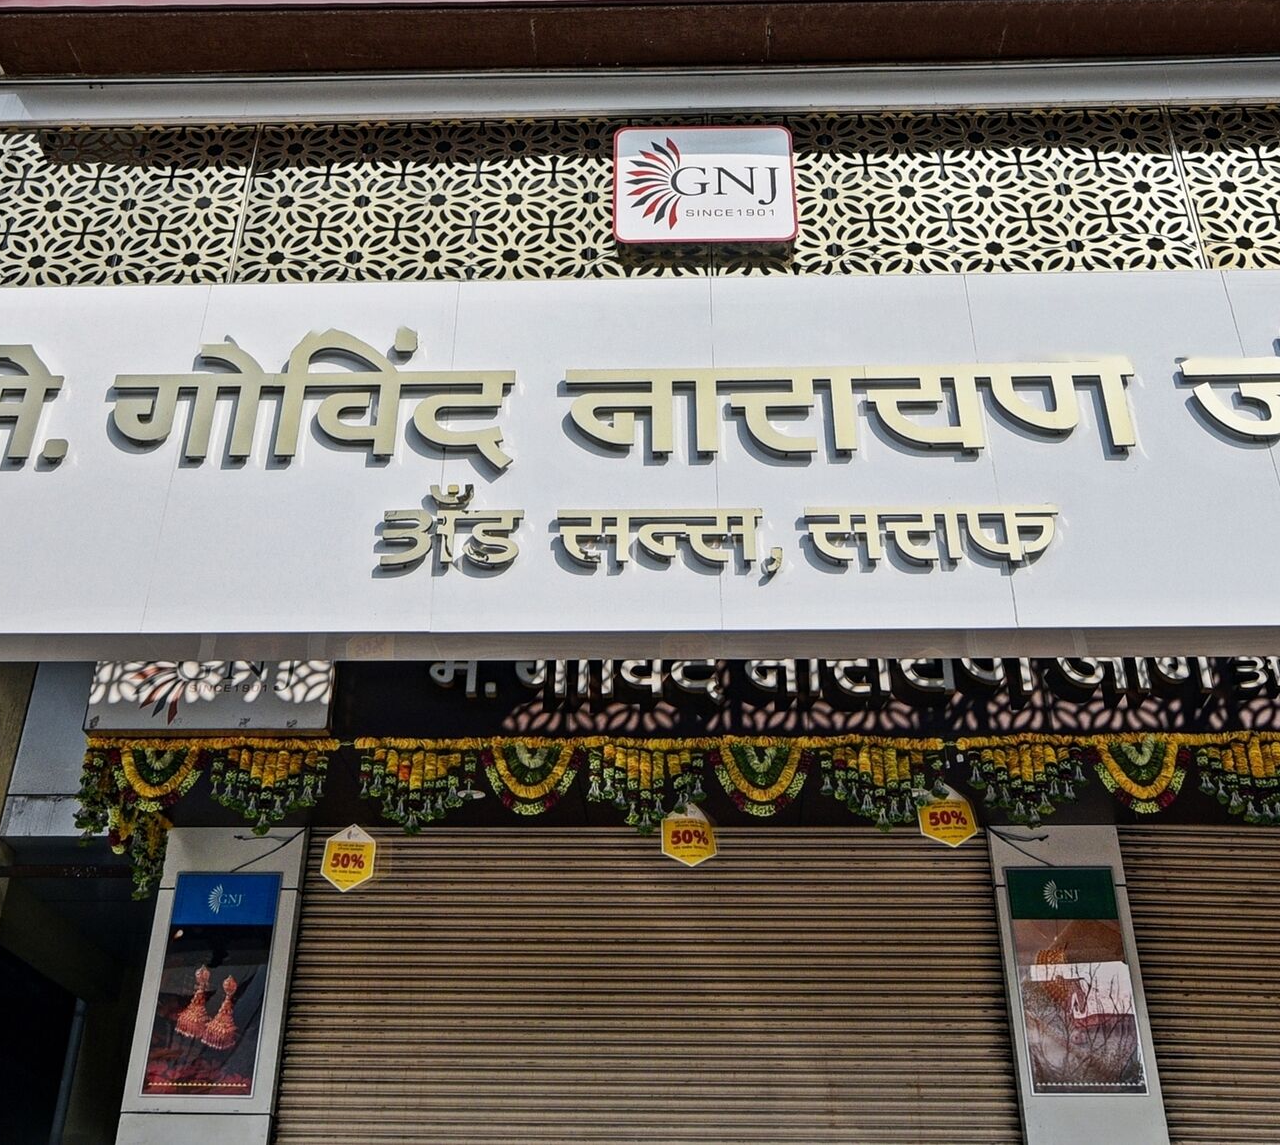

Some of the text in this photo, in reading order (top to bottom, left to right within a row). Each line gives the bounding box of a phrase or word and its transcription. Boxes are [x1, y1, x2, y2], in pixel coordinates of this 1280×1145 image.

[670, 166, 780, 205] GNJ
[113, 327, 516, 470] गोविंद
[565, 360, 1136, 454] नारायण
[803, 505, 1060, 563] सराफ
[928, 810, 968, 827] 50%
[670, 829, 710, 846] 50%
[330, 852, 365, 870] 50%
[218, 893, 243, 907] GNJ
[1053, 888, 1079, 902] GNJ
